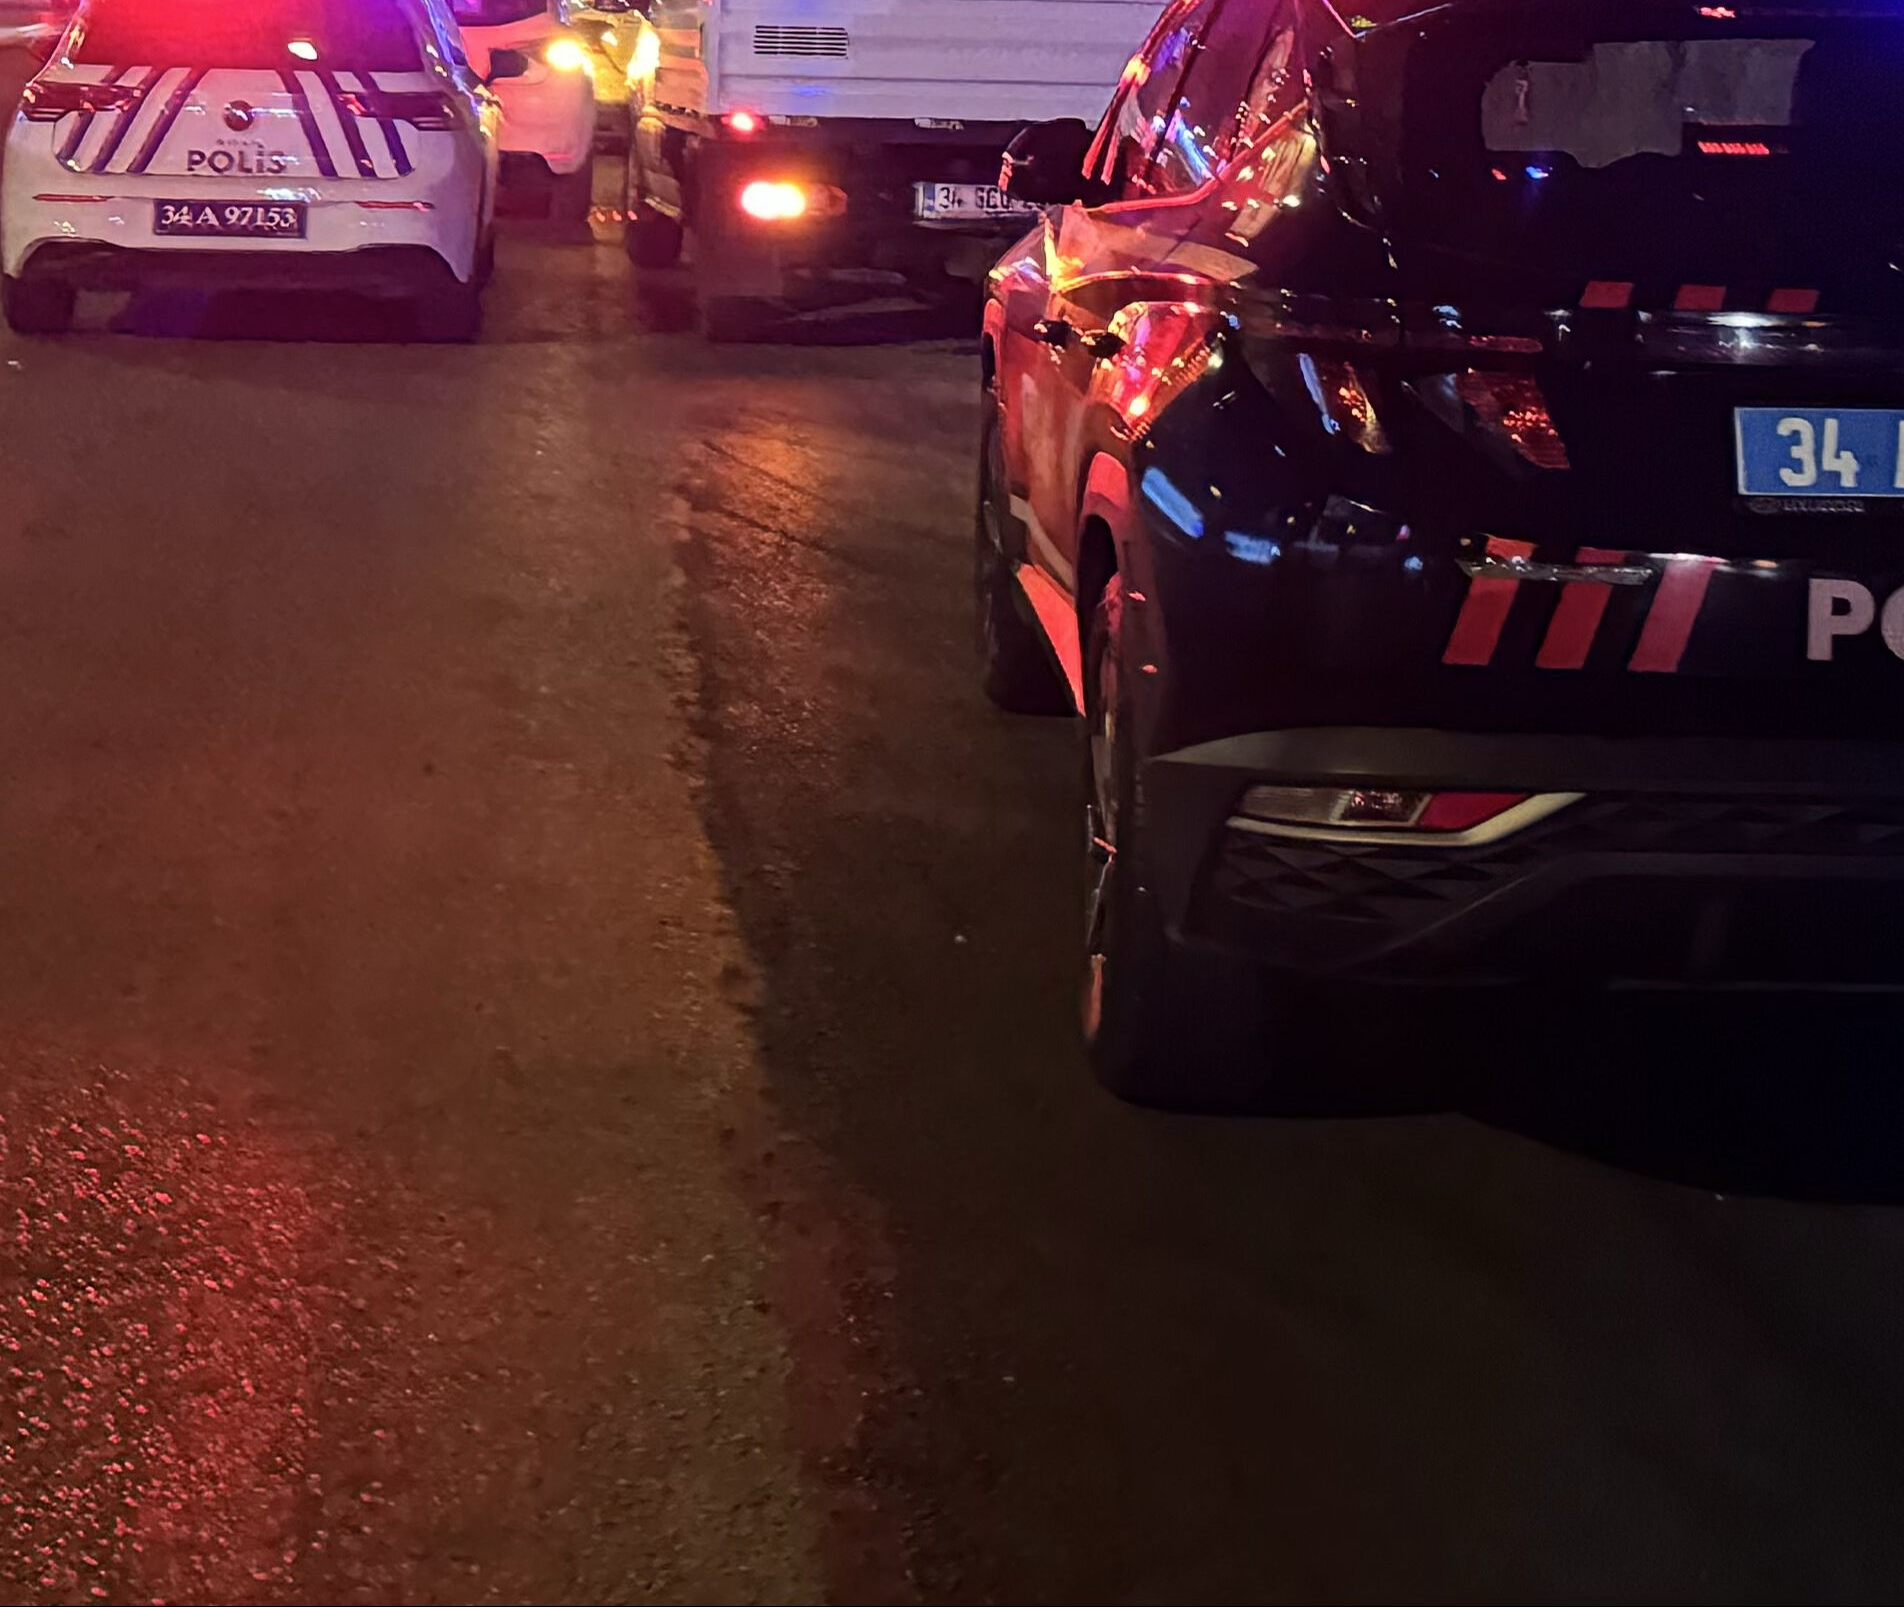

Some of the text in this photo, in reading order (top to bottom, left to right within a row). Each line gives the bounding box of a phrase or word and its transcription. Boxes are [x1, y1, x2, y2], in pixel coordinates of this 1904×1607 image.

[161, 205, 193, 227] 34
[196, 206, 220, 227] A
[1776, 417, 1859, 488] 34
